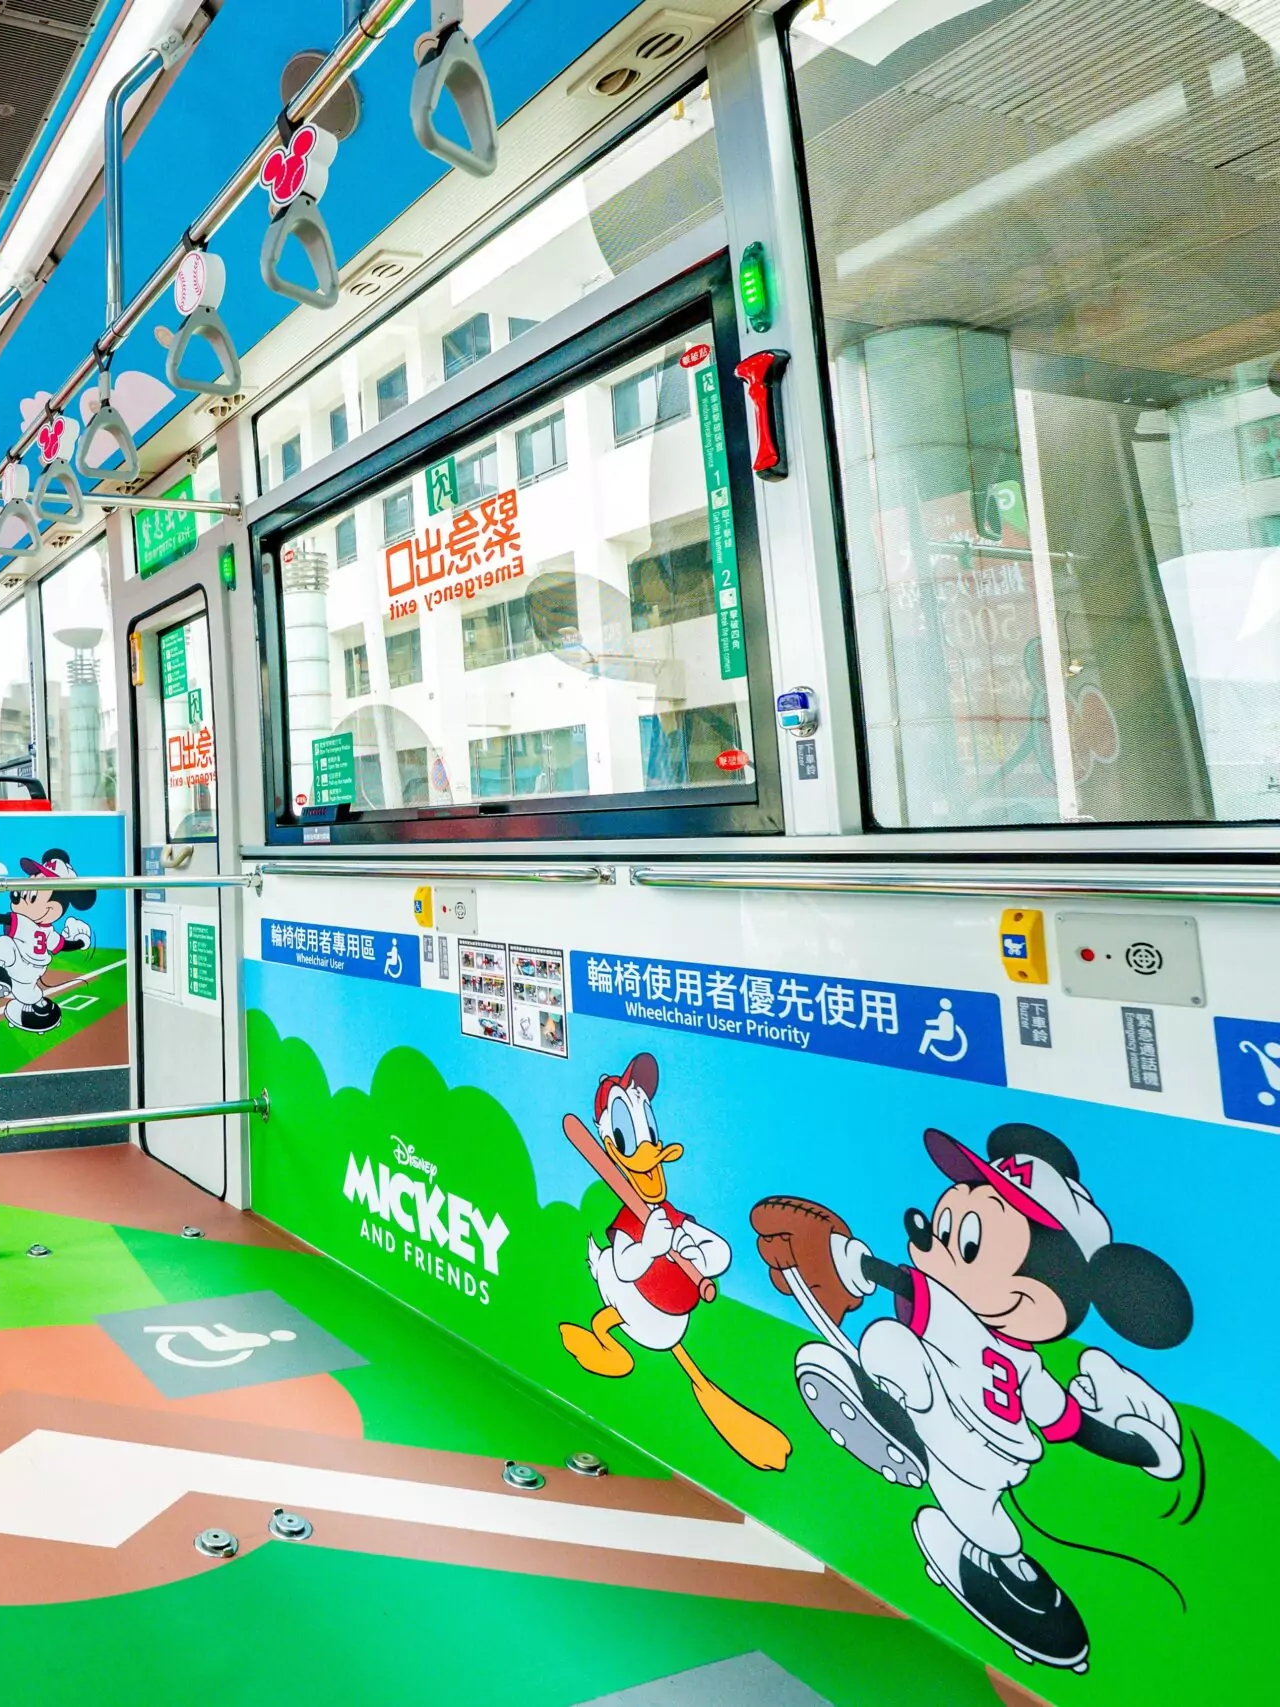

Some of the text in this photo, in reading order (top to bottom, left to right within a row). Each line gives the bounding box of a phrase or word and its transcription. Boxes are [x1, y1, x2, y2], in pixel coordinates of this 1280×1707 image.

[714, 470, 720, 486] 1
[721, 570, 731, 586] 2
[33, 930, 47, 955] 3
[271, 922, 376, 960] 輪椅使用者專用區
[296, 953, 345, 971] Wheelchair User
[586, 956, 900, 1036] 輪椅使用者優先使用
[1020, 1002, 1030, 1029] Buzzer
[625, 1001, 811, 1049] Wheelchair User Priority
[1030, 1003, 1049, 1043] 下車鈴
[1124, 1012, 1137, 1052] Emergency
[343, 1151, 510, 1277] MICKEY
[360, 1218, 491, 1305] AND FRIENDS
[982, 1346, 1022, 1425] 3
